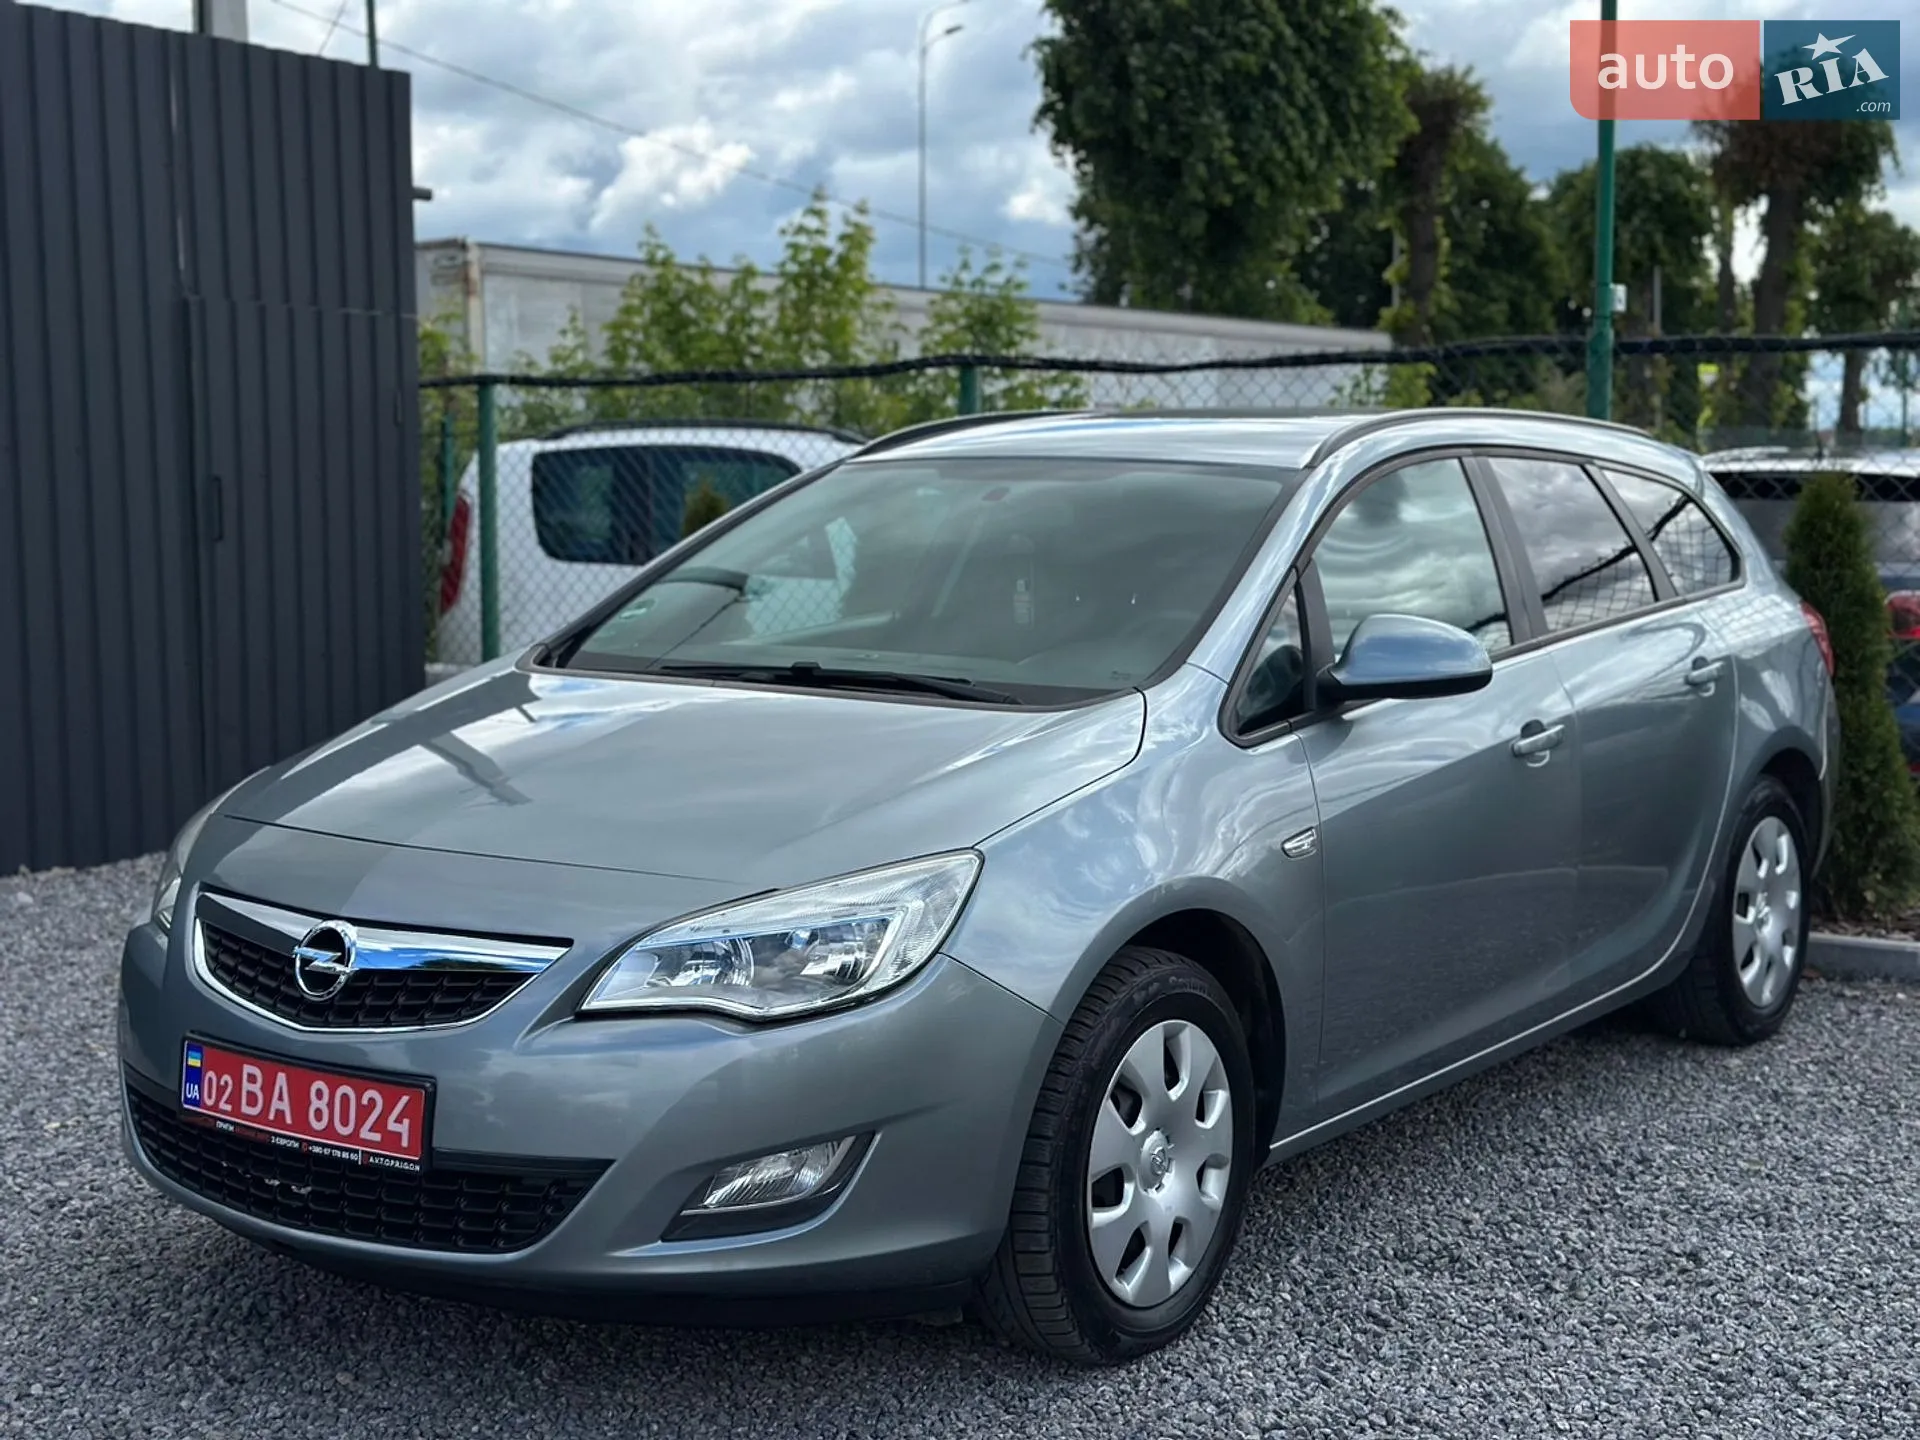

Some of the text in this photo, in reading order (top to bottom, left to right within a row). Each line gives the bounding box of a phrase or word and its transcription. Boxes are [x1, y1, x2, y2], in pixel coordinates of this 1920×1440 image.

[186, 1083, 200, 1101] UA
[203, 1064, 410, 1148] 02 BA 8024
